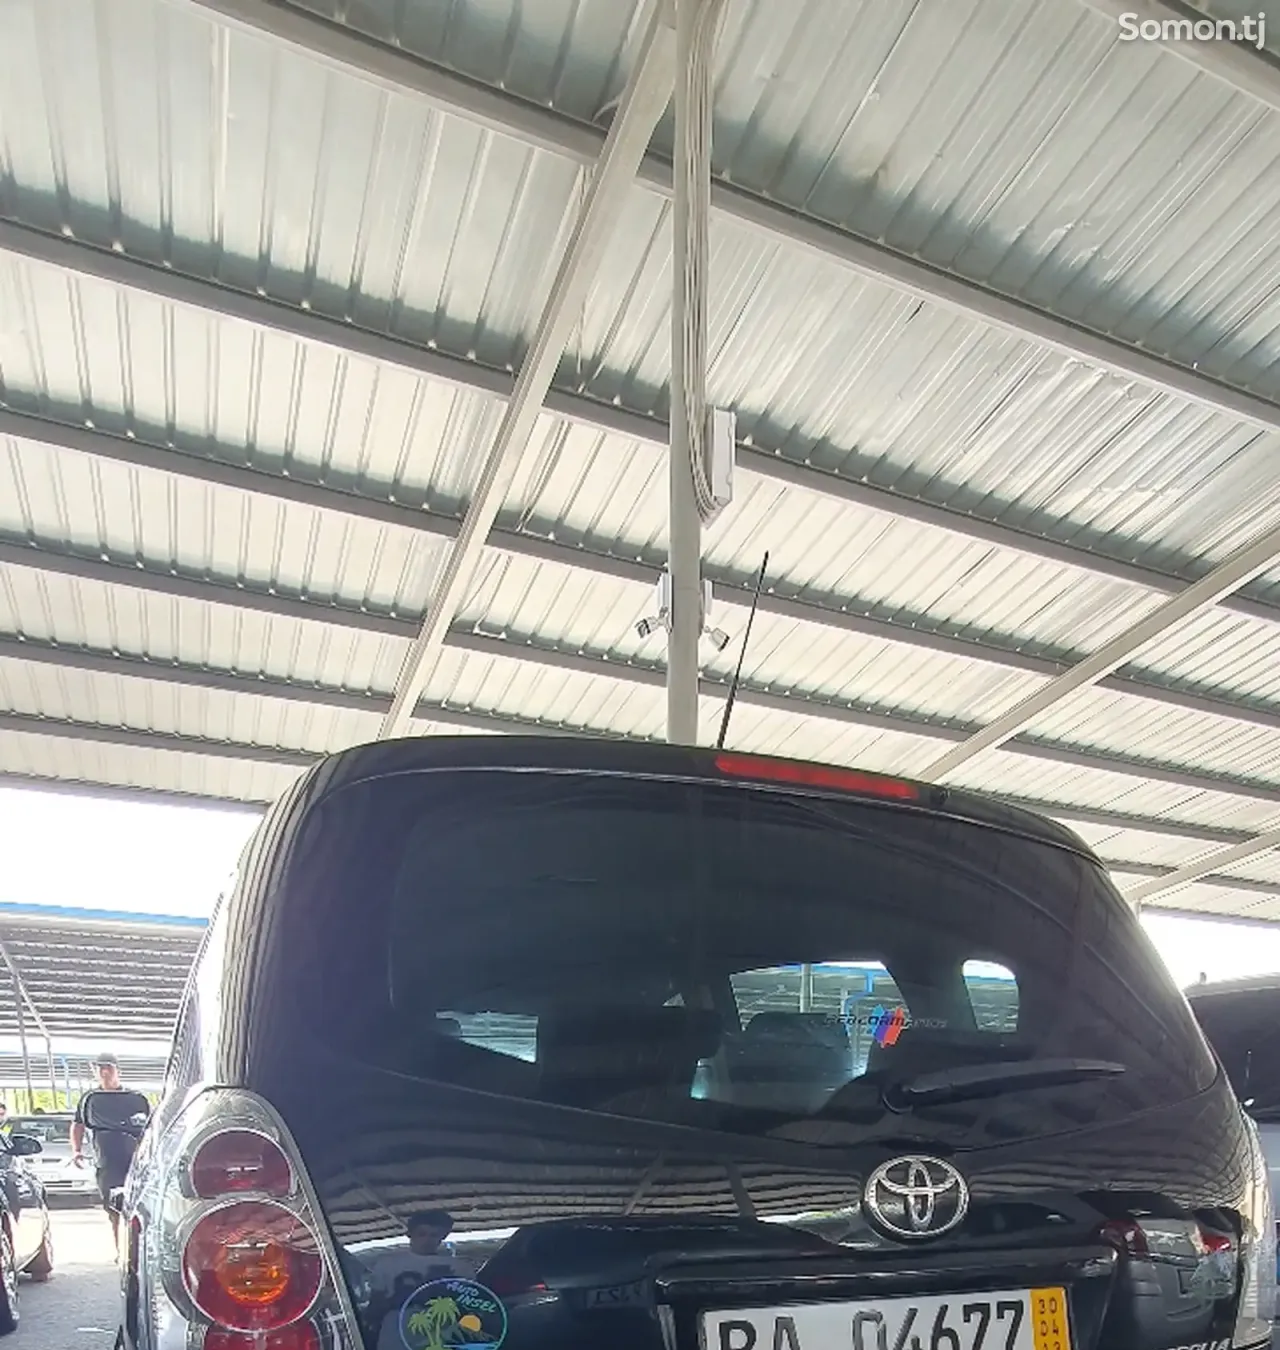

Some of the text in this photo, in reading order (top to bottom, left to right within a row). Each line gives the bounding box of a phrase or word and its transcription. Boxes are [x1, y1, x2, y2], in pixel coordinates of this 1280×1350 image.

[446, 1281, 479, 1297] AUTO
[456, 1294, 497, 1312] INSEL
[1038, 1297, 1058, 1315] 30
[1040, 1319, 1060, 1337] 04
